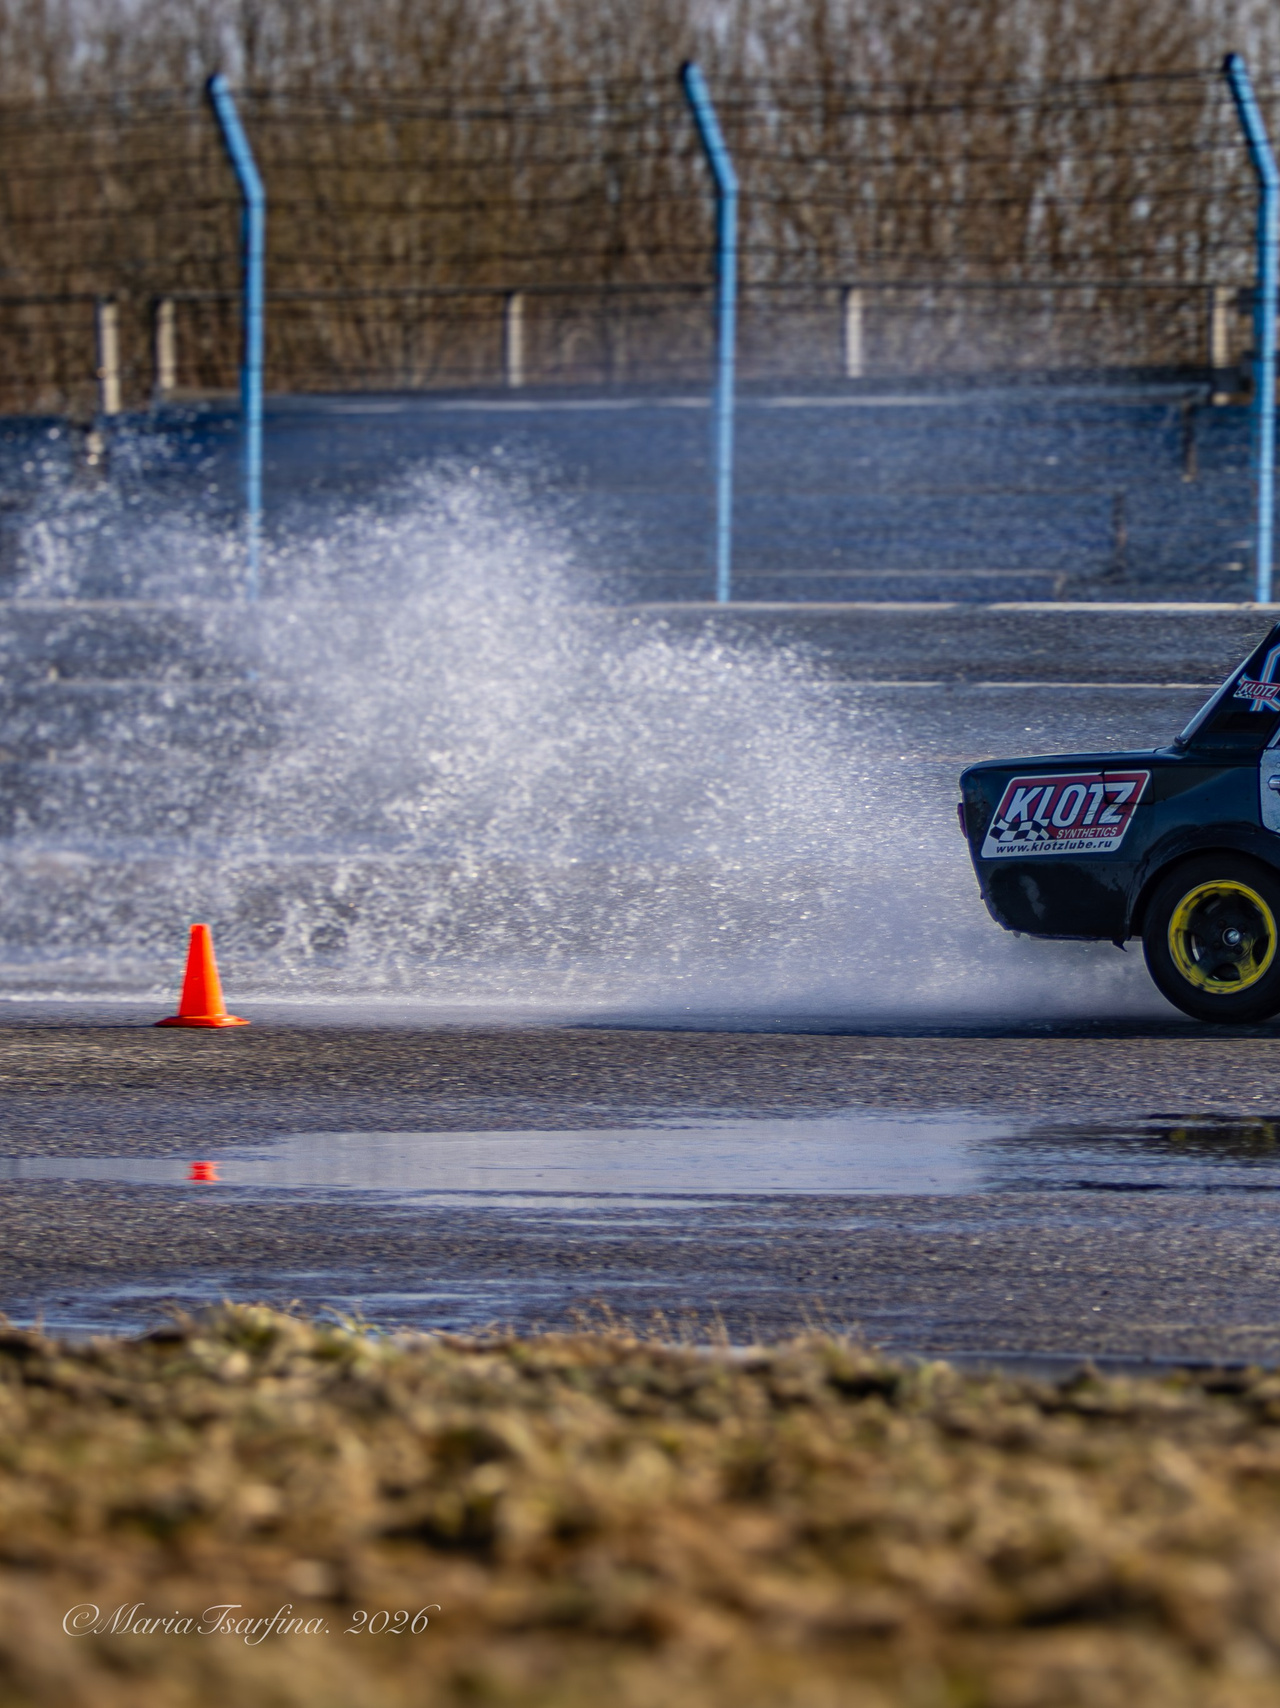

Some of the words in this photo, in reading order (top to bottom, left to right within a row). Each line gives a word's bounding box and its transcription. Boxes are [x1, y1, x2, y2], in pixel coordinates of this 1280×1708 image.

[1240, 683, 1278, 697] KLOTZ
[1004, 781, 1137, 828] KLOTZ
[1056, 827, 1118, 839] SYNTHETICS
[996, 839, 1113, 854] www.klotzlube.ru
